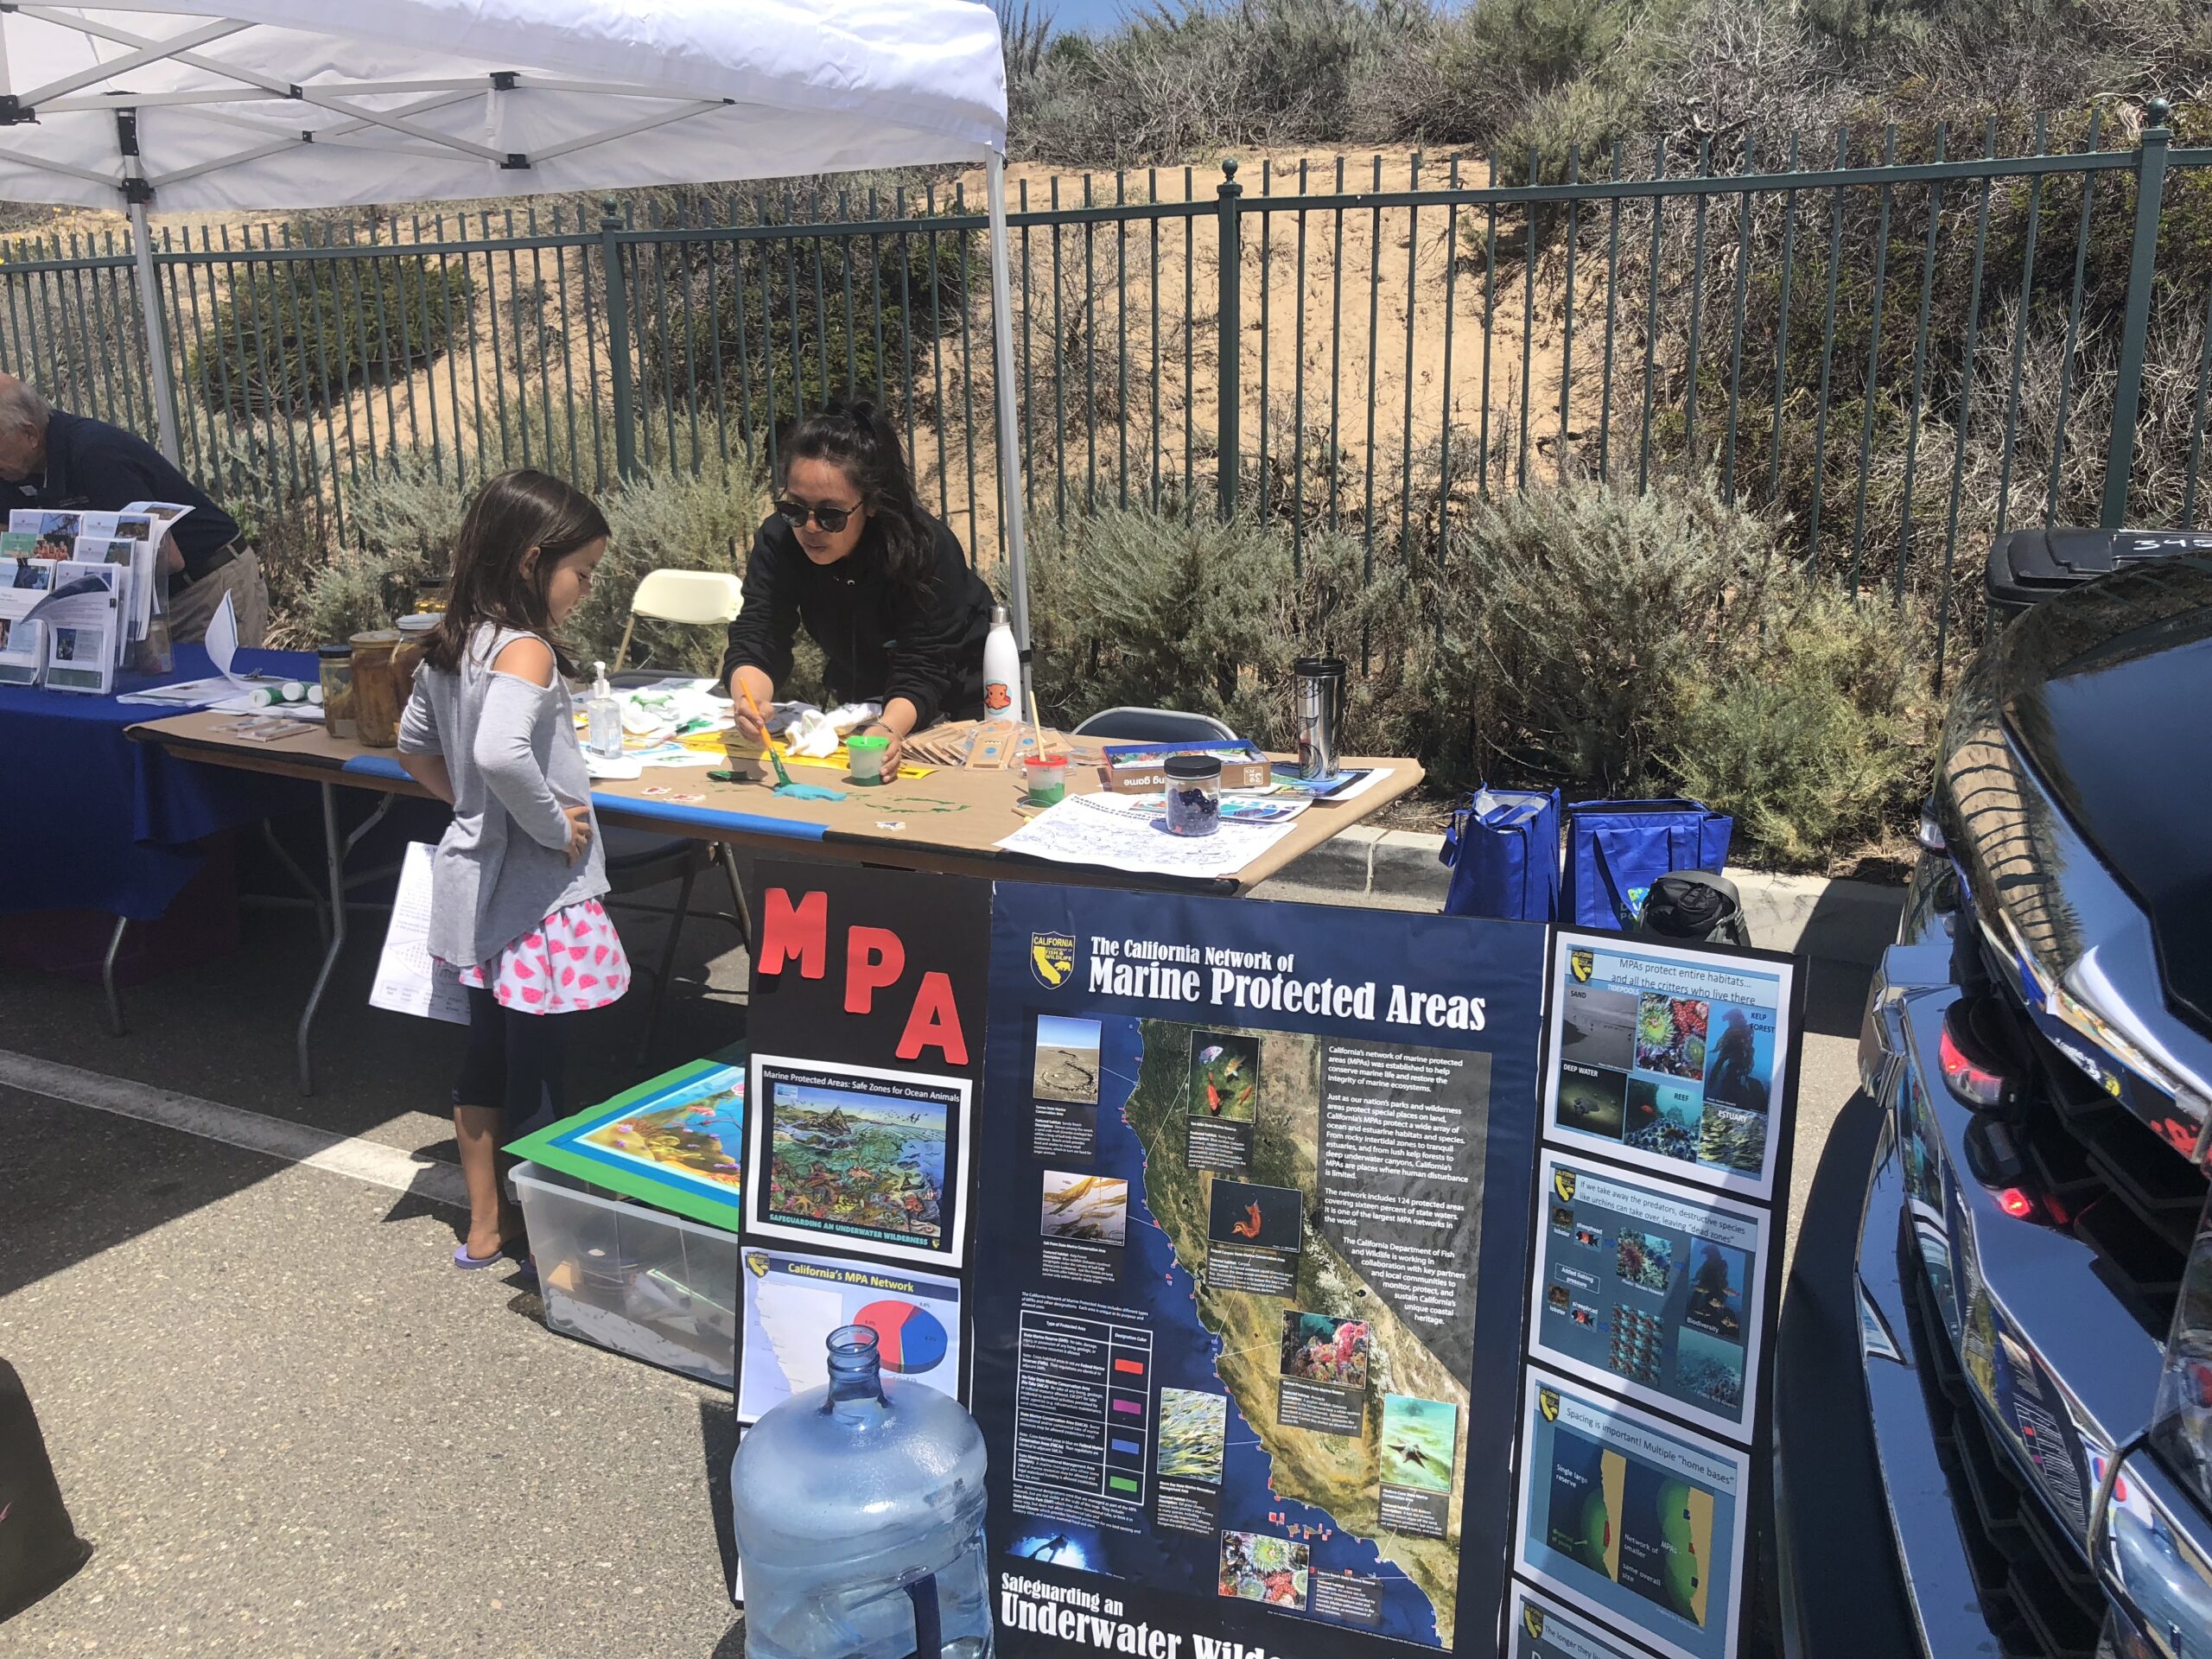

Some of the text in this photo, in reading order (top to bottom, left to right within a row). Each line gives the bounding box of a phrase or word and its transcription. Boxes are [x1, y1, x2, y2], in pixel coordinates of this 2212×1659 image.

[1123, 776, 1151, 785] game
[1033, 936, 1073, 947] CALIFORNIA
[1091, 936, 1294, 972] The California Network of
[1619, 959, 1643, 971] MPAs
[1644, 965, 1675, 976] protect
[1678, 969, 1705, 981] entire
[1089, 957, 1486, 1031] Marine Protected Areas
[1571, 990, 1586, 999] SAND
[1607, 983, 1640, 995] TIDEPOOLS
[1611, 975, 1756, 1005] and all the critters who live there
[1750, 1023, 1775, 1033] FOREST
[1329, 1047, 1364, 1057] California's
[1365, 1051, 1394, 1059] network
[1427, 1058, 1463, 1066] protected
[1346, 1058, 1370, 1069] (MPAs)
[1385, 1063, 1424, 1071] established
[1433, 1066, 1450, 1077] help
[1563, 1064, 1599, 1077] DEEP WATER
[764, 1071, 959, 1102] Marine Protected Areas: Safe Zones for Ocean Animals
[1328, 1074, 1356, 1085] integrity
[1389, 1083, 1431, 1092] ecosystems.
[1409, 1075, 1434, 1084] restore
[1363, 1098, 1389, 1107] nation's
[1424, 1104, 1462, 1115] wilderness
[1674, 1093, 1689, 1102] REEF
[1429, 1114, 1446, 1124] land,
[1719, 1110, 1748, 1122] ESTUARY
[1325, 1187, 1338, 1196] The
[1338, 1190, 1366, 1199] network
[1367, 1192, 1395, 1203] includes
[1410, 1199, 1445, 1209] protected
[1325, 1198, 1353, 1209] covering
[1355, 1201, 1379, 1211] sixteen
[1433, 1211, 1459, 1220] waters.
[1580, 1192, 1590, 1201] like
[1591, 1198, 1614, 1209] urchins
[1630, 1207, 1643, 1217] take
[1644, 1212, 1660, 1223] over,
[1662, 1216, 1686, 1231] leaving
[1597, 1186, 1611, 1196] take
[1611, 1192, 1629, 1202] away
[1630, 1195, 1641, 1204] the
[1643, 1201, 1676, 1216] predators,
[1679, 1210, 1717, 1226] destructive
[1719, 1222, 1745, 1235] species
[770, 1214, 821, 1229] SAFEGUARDING
[835, 1224, 881, 1238] UNDERWATER
[884, 1232, 928, 1246] WILDERNESS
[1357, 1239, 1389, 1249] California
[1389, 1243, 1431, 1255] Department
[1440, 1249, 1455, 1258] Fish
[788, 1263, 914, 1293] California's MPA Network
[1361, 1260, 1406, 1271] collaboration
[1423, 1267, 1435, 1276] key
[1436, 1270, 1465, 1279] partners
[1687, 1318, 1719, 1333] Biodiversity
[1567, 1408, 1593, 1427] Spacing
[1594, 1420, 1600, 1429] is
[1602, 1423, 1642, 1446] important!
[1643, 1440, 1675, 1460] Multiple
[1556, 1464, 1573, 1477] Single
[1555, 1474, 1577, 1487] reserve
[1624, 1534, 1650, 1551] Network
[1624, 1544, 1646, 1558] smaller
[1622, 1573, 1634, 1582] size
[1623, 1563, 1661, 1586] same overall
[1001, 1573, 1123, 1617] Safeguarding an
[1001, 1591, 1181, 1659] Underwater
[1545, 1625, 1555, 1636] The
[1557, 1632, 1576, 1648] longer
